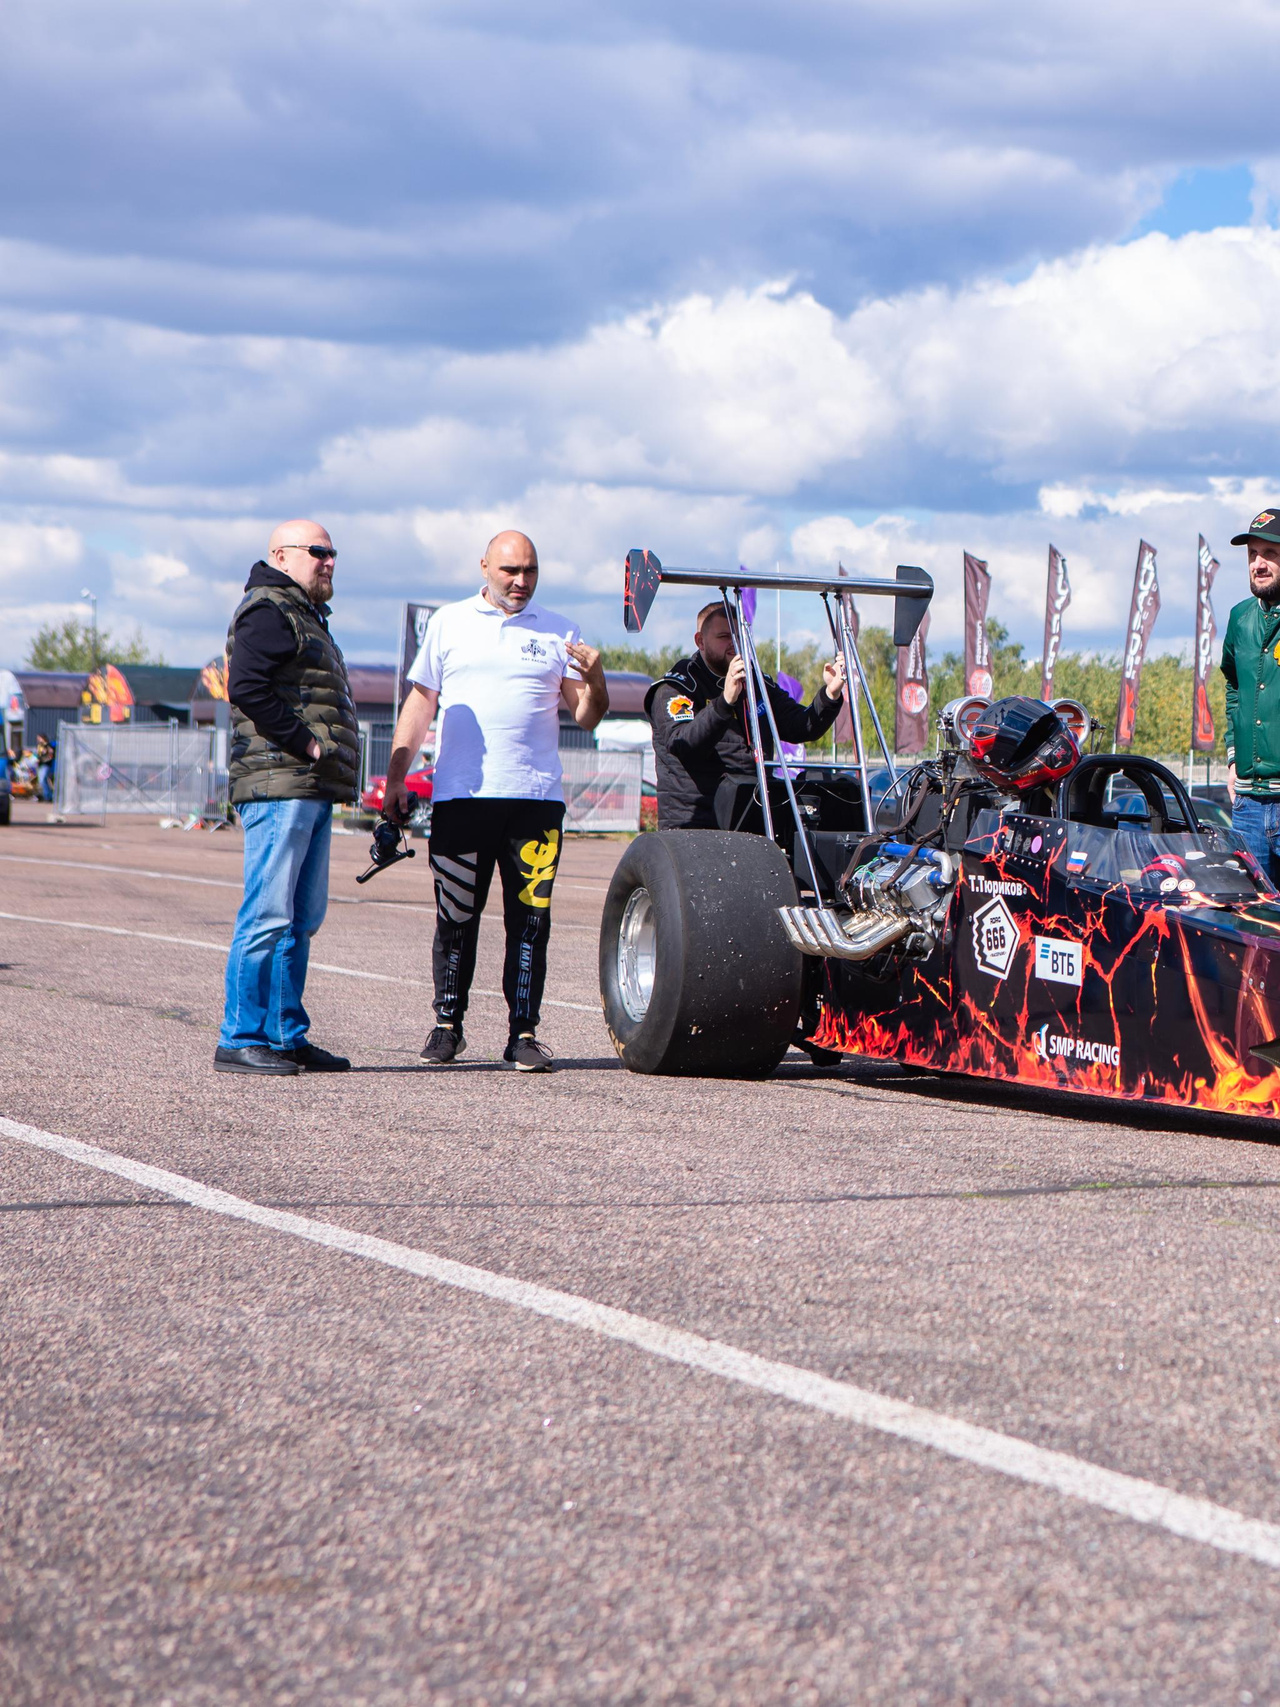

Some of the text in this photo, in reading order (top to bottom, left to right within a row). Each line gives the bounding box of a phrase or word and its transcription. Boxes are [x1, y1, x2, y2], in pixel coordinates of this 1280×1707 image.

[974, 620, 984, 665] Ramon
[968, 875, 1023, 897] Т.Тюриков
[985, 925, 1006, 951] 666
[1051, 950, 1075, 976] ВТБ
[1049, 1034, 1120, 1066] SMP RACING
